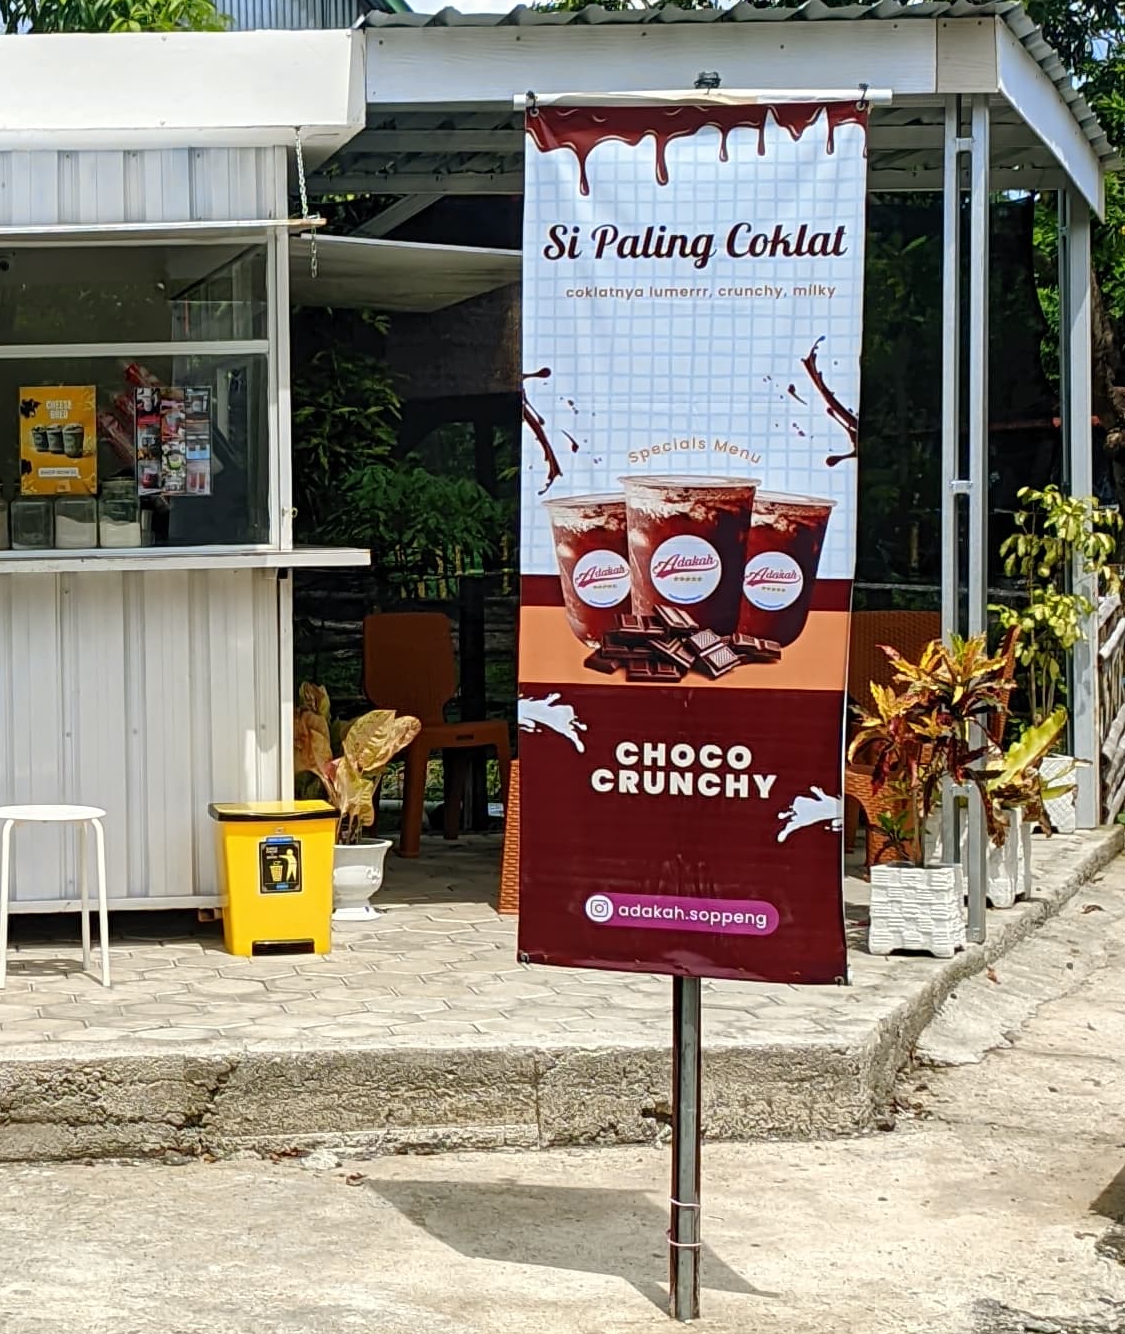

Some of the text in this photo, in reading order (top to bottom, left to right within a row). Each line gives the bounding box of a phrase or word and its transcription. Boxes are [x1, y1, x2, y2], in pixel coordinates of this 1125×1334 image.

[543, 222, 849, 269] Si Paling Coklat
[566, 286, 644, 300] coklatnya
[718, 284, 788, 299] crunchy,
[793, 283, 836, 299] milky
[628, 436, 762, 464] Specials Menu
[576, 565, 626, 587] Adakah
[654, 554, 715, 578] Adakah
[615, 742, 752, 769] CHOCO
[591, 769, 777, 798] CRUNCHY
[618, 902, 767, 929] adakah.soppeng
